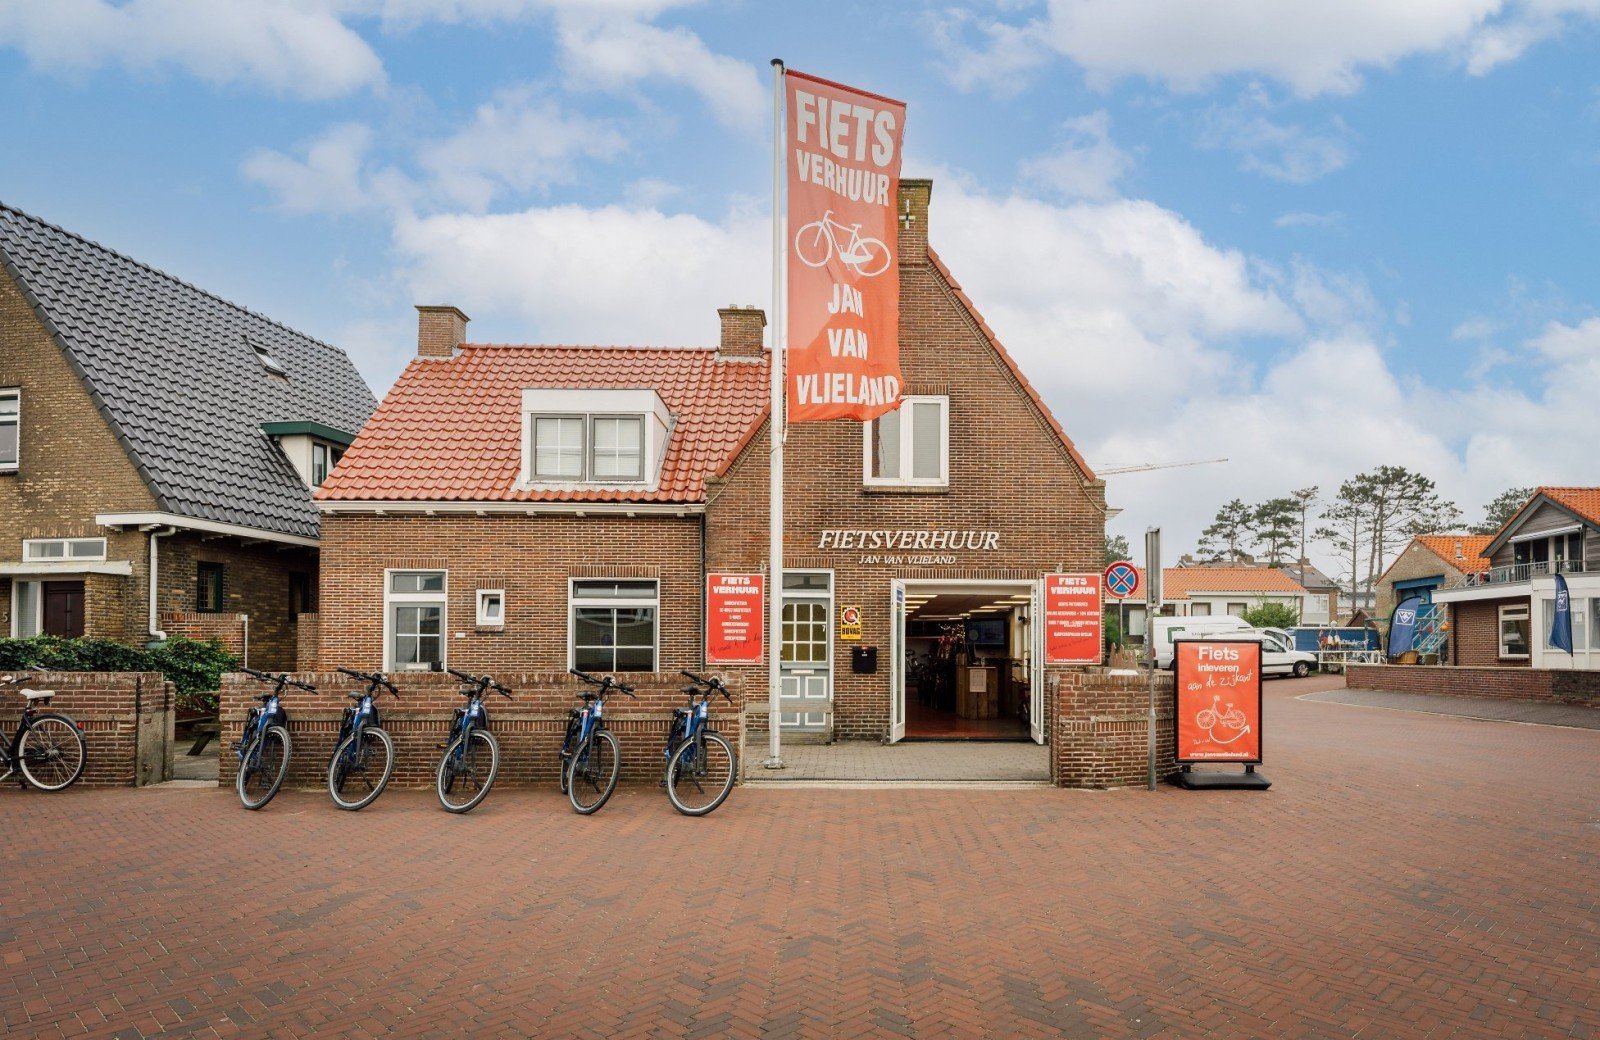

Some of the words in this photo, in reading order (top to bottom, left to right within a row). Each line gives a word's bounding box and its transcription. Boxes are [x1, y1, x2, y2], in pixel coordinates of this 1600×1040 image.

[796, 90, 896, 167] FIETS
[796, 149, 890, 207] VERHUUR
[828, 283, 864, 318] JAN
[828, 328, 868, 360] VAN
[796, 373, 899, 405] VLIELAND
[818, 530, 1000, 550] FIETSVERHUUR
[859, 555, 880, 565] JAN
[884, 556, 902, 565] VAN
[907, 556, 956, 565] VLIELAND
[721, 577, 751, 585] FIETS
[1058, 577, 1088, 586] FIETS
[713, 586, 759, 595] VERHUUR
[1050, 587, 1096, 595] VERHUUR
[0, 612, 8, 623] 5
[842, 627, 861, 635] BOVAG
[1198, 646, 1239, 661] Fiets
[1197, 663, 1240, 672] inleveren
[1206, 673, 1216, 688] de
